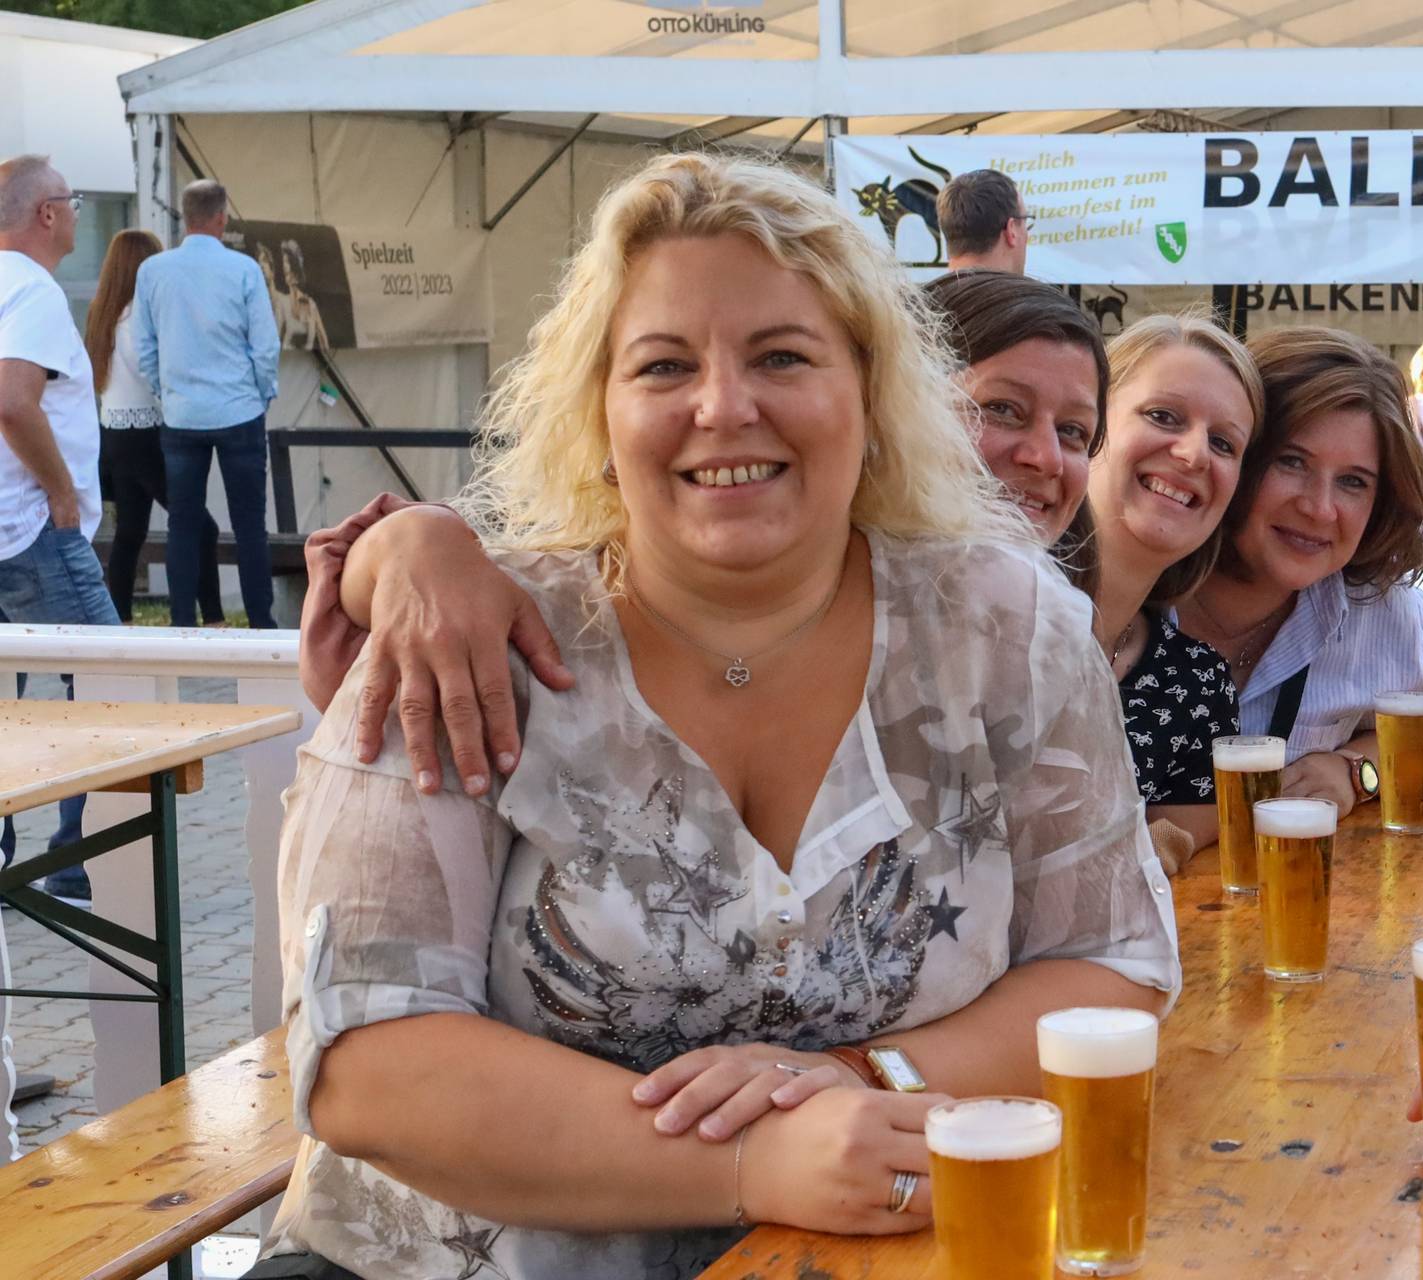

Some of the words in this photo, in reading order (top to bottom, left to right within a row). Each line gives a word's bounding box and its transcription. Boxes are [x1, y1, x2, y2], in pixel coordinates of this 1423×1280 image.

[648, 17, 691, 33] OTTO
[990, 150, 1076, 173] Herzlich
[1017, 175, 1116, 196] lkommen
[1123, 170, 1168, 187] zum
[1025, 196, 1121, 220] ützenfest
[1130, 194, 1156, 209] im
[1026, 218, 1143, 246] erwehrzelt!
[351, 241, 415, 270] Spielzeit
